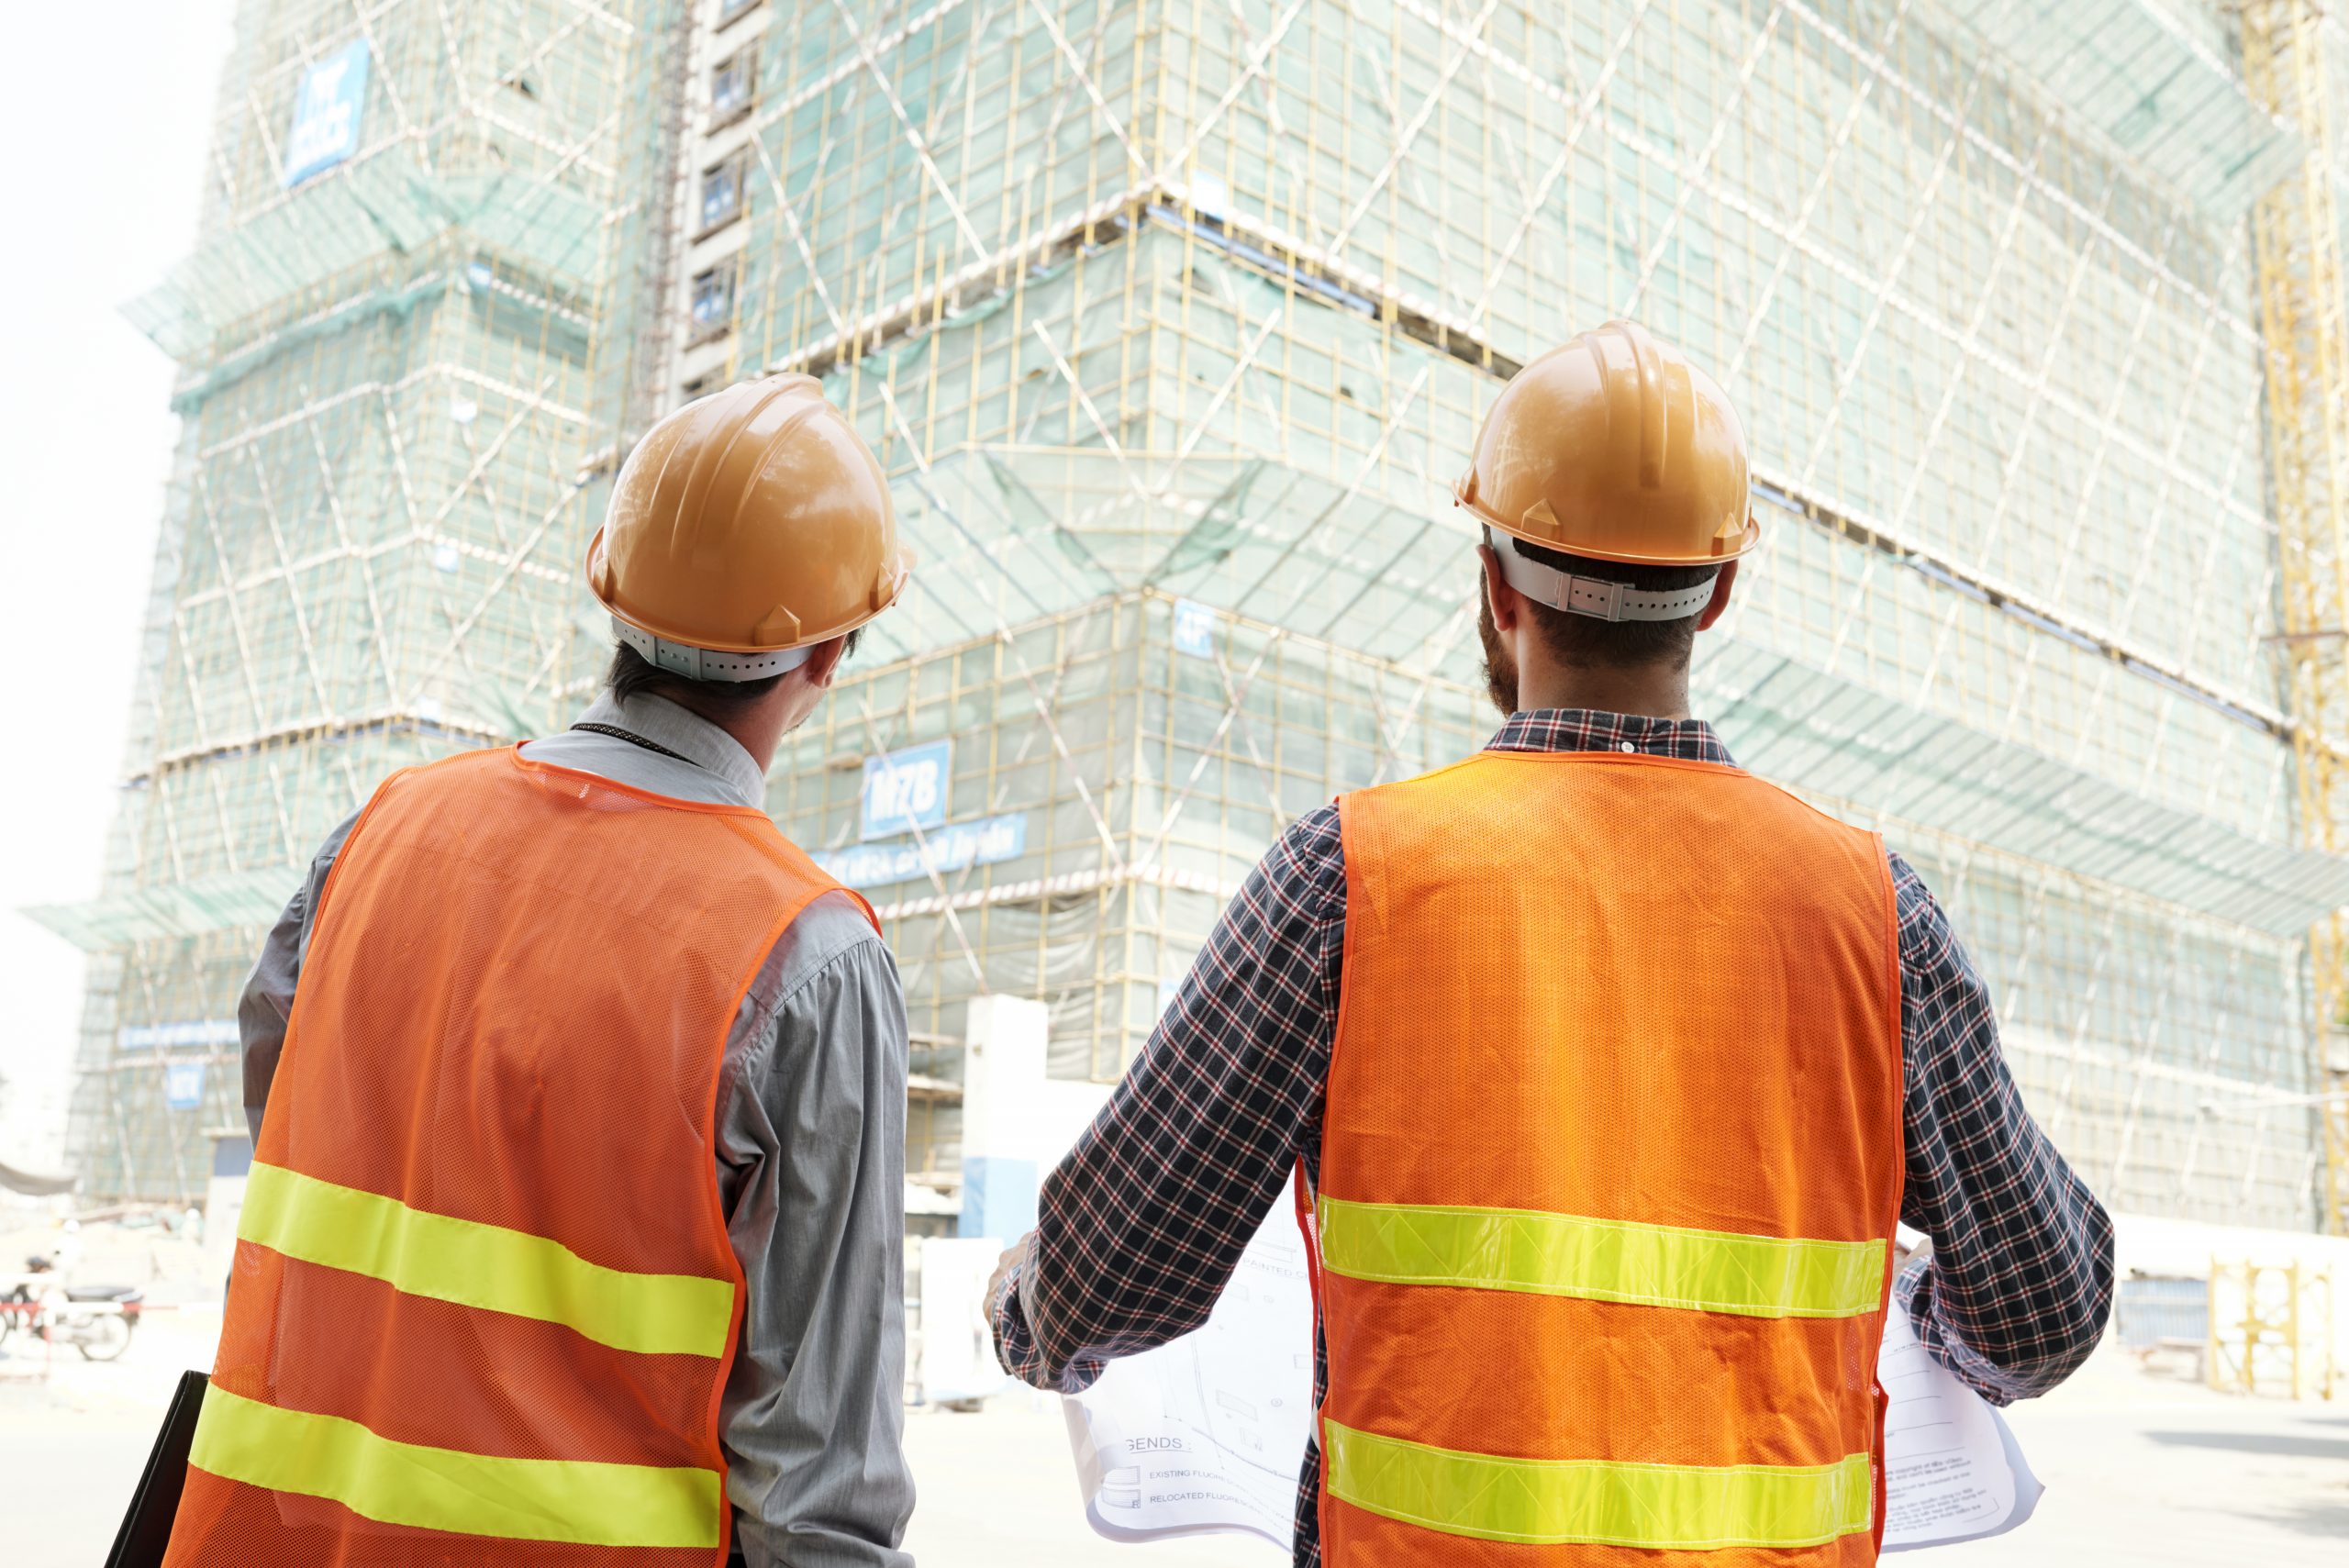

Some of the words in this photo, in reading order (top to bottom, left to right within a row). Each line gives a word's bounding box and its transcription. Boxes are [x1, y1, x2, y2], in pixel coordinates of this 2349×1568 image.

[1243, 1257, 1292, 1276] PAINTED
[1150, 1470, 1191, 1479] EXISTING
[1150, 1492, 1205, 1504] RELOCATED
